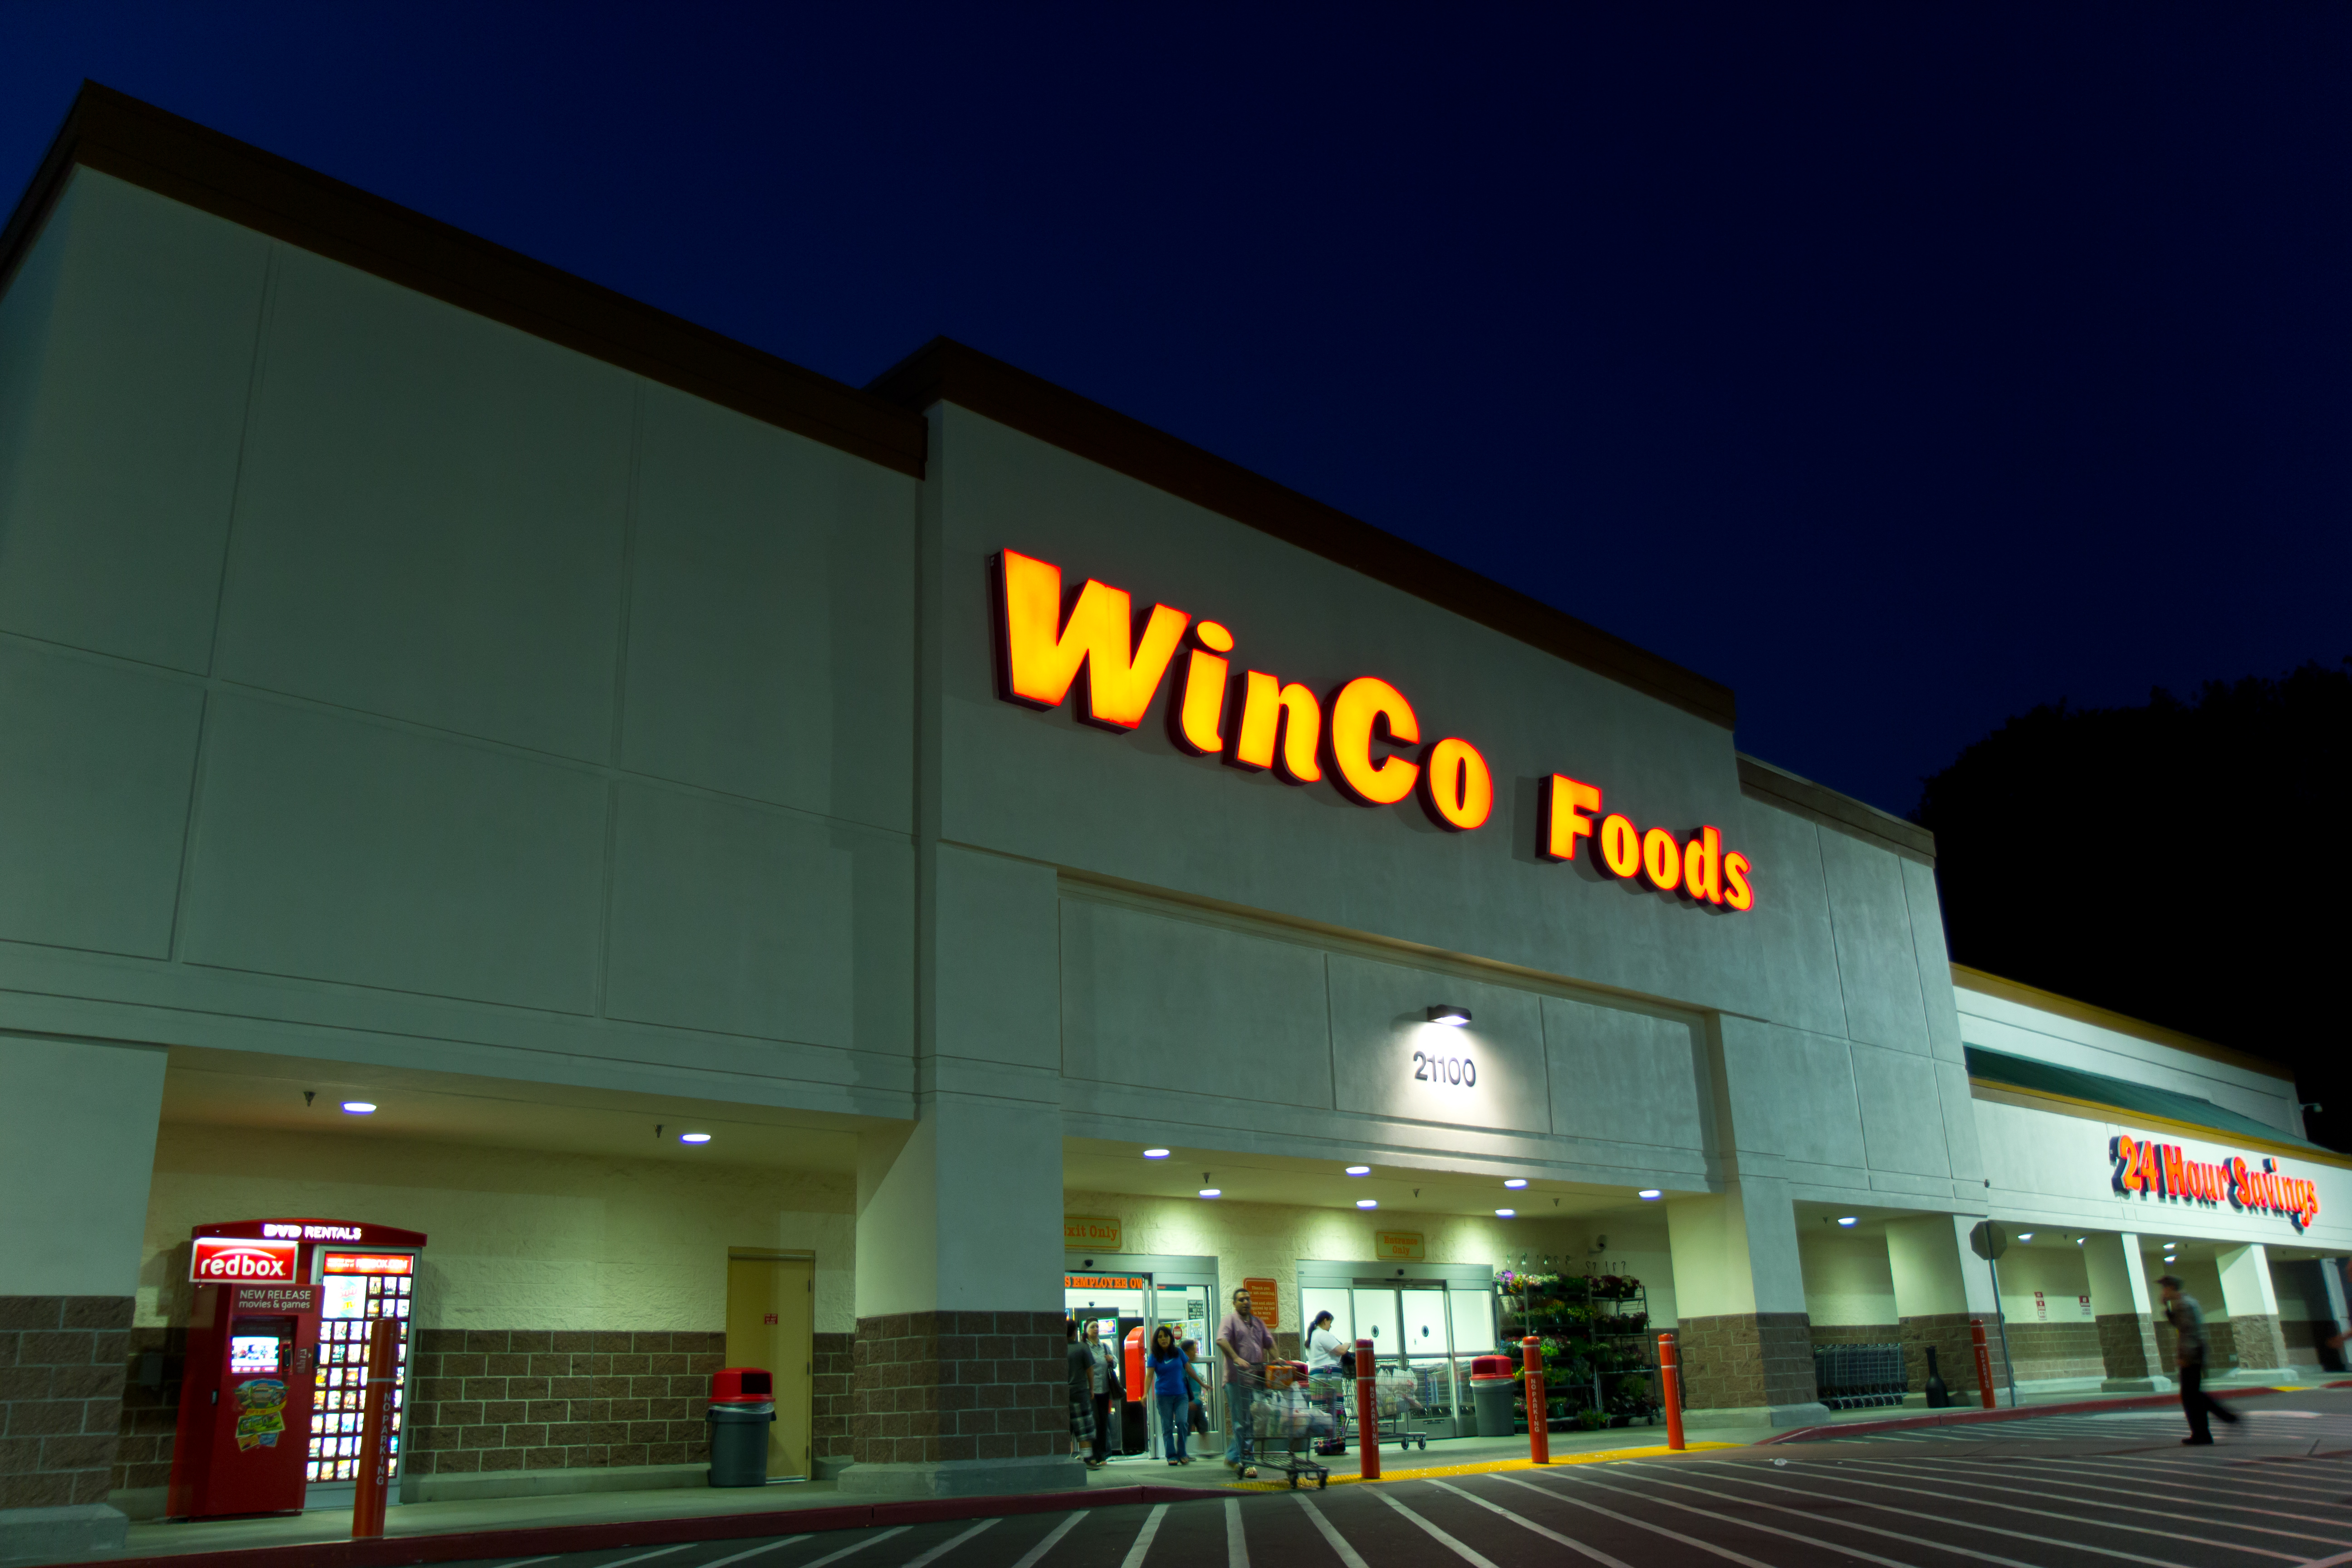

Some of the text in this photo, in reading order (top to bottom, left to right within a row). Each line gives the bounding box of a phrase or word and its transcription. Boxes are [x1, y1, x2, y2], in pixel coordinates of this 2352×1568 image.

[1001, 548, 1753, 912] WinCo Foods
[1413, 1050, 1476, 1087] 21100
[2116, 1134, 2320, 1228] 24 Hour Savings
[263, 1224, 362, 1240] DVD RENTALS
[1089, 1225, 1118, 1241] Only
[1384, 1235, 1418, 1245] Entrance
[1392, 1246, 1410, 1256] Only
[200, 1255, 284, 1276] redbox
[1071, 1276, 1128, 1289] EMPLOYEE
[240, 1290, 311, 1300] NEW RELEASE
[239, 1300, 310, 1310] movies & games
[1980, 1350, 1989, 1388] NO PARKING
[1370, 1386, 1375, 1398] NO
[1530, 1378, 1536, 1390] NO
[377, 1393, 391, 1485] NO PARKING
